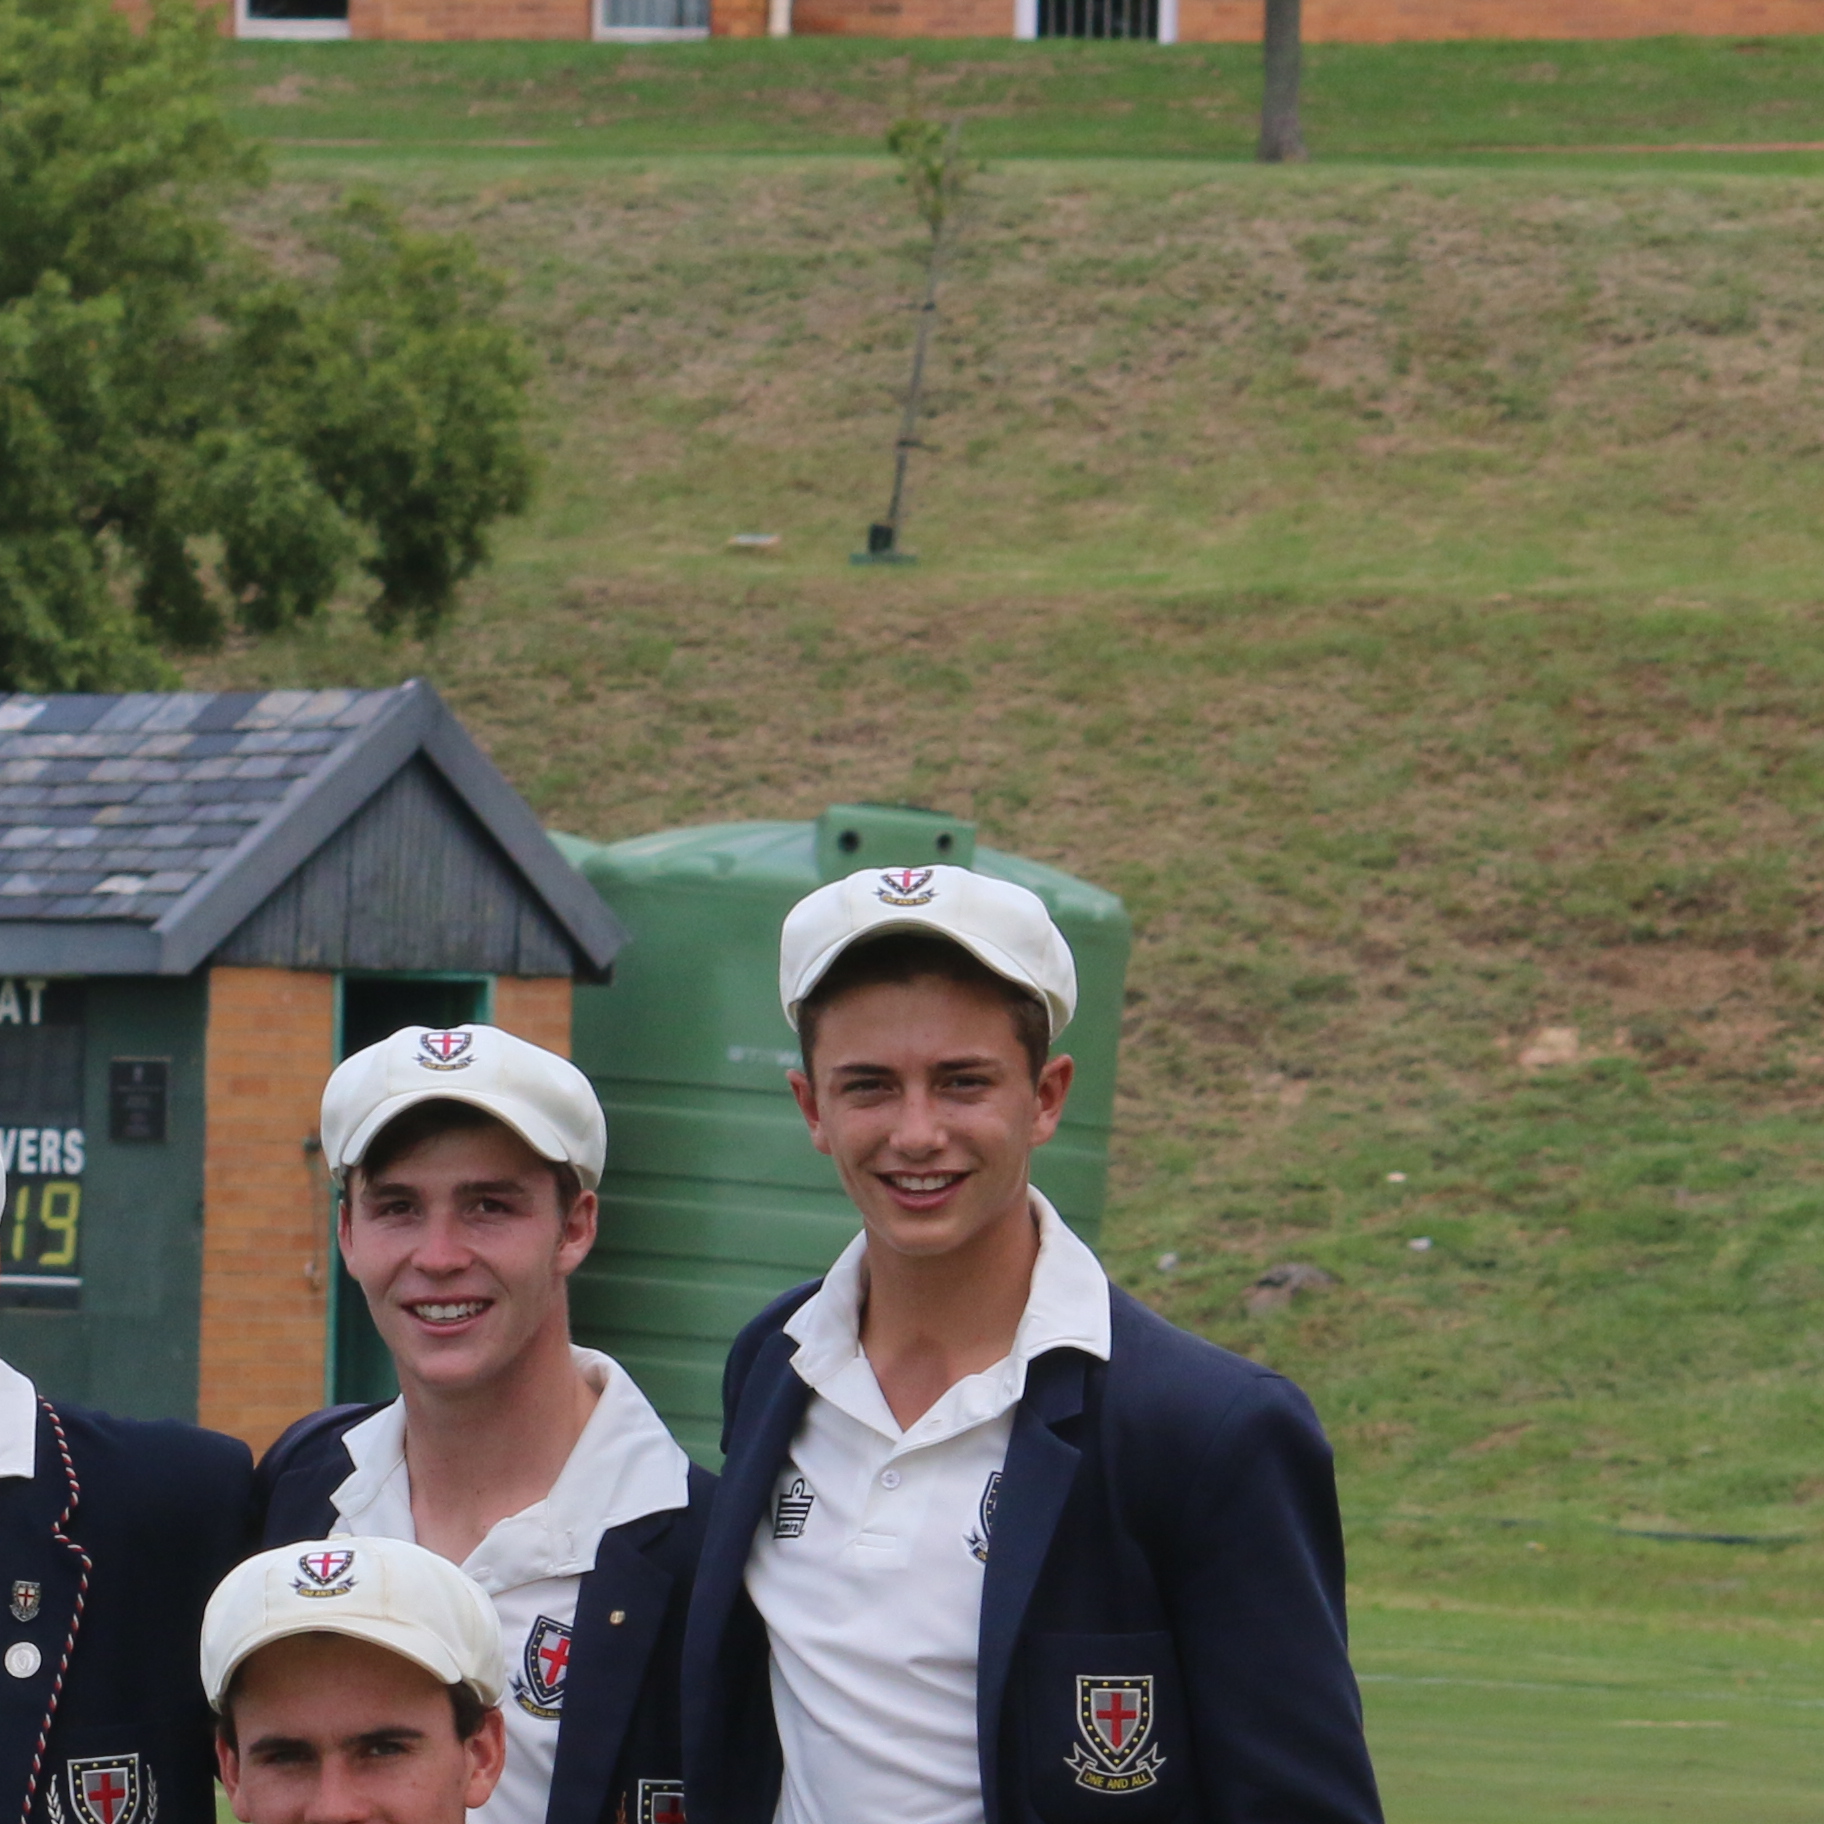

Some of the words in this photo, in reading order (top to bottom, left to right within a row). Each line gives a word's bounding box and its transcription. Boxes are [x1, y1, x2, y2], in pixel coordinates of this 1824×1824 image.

[11, 1181, 82, 1265] 19
[1083, 1772, 1104, 1786] ONE
[1106, 1777, 1129, 1789] AND
[1131, 1773, 1150, 1787] ALL
